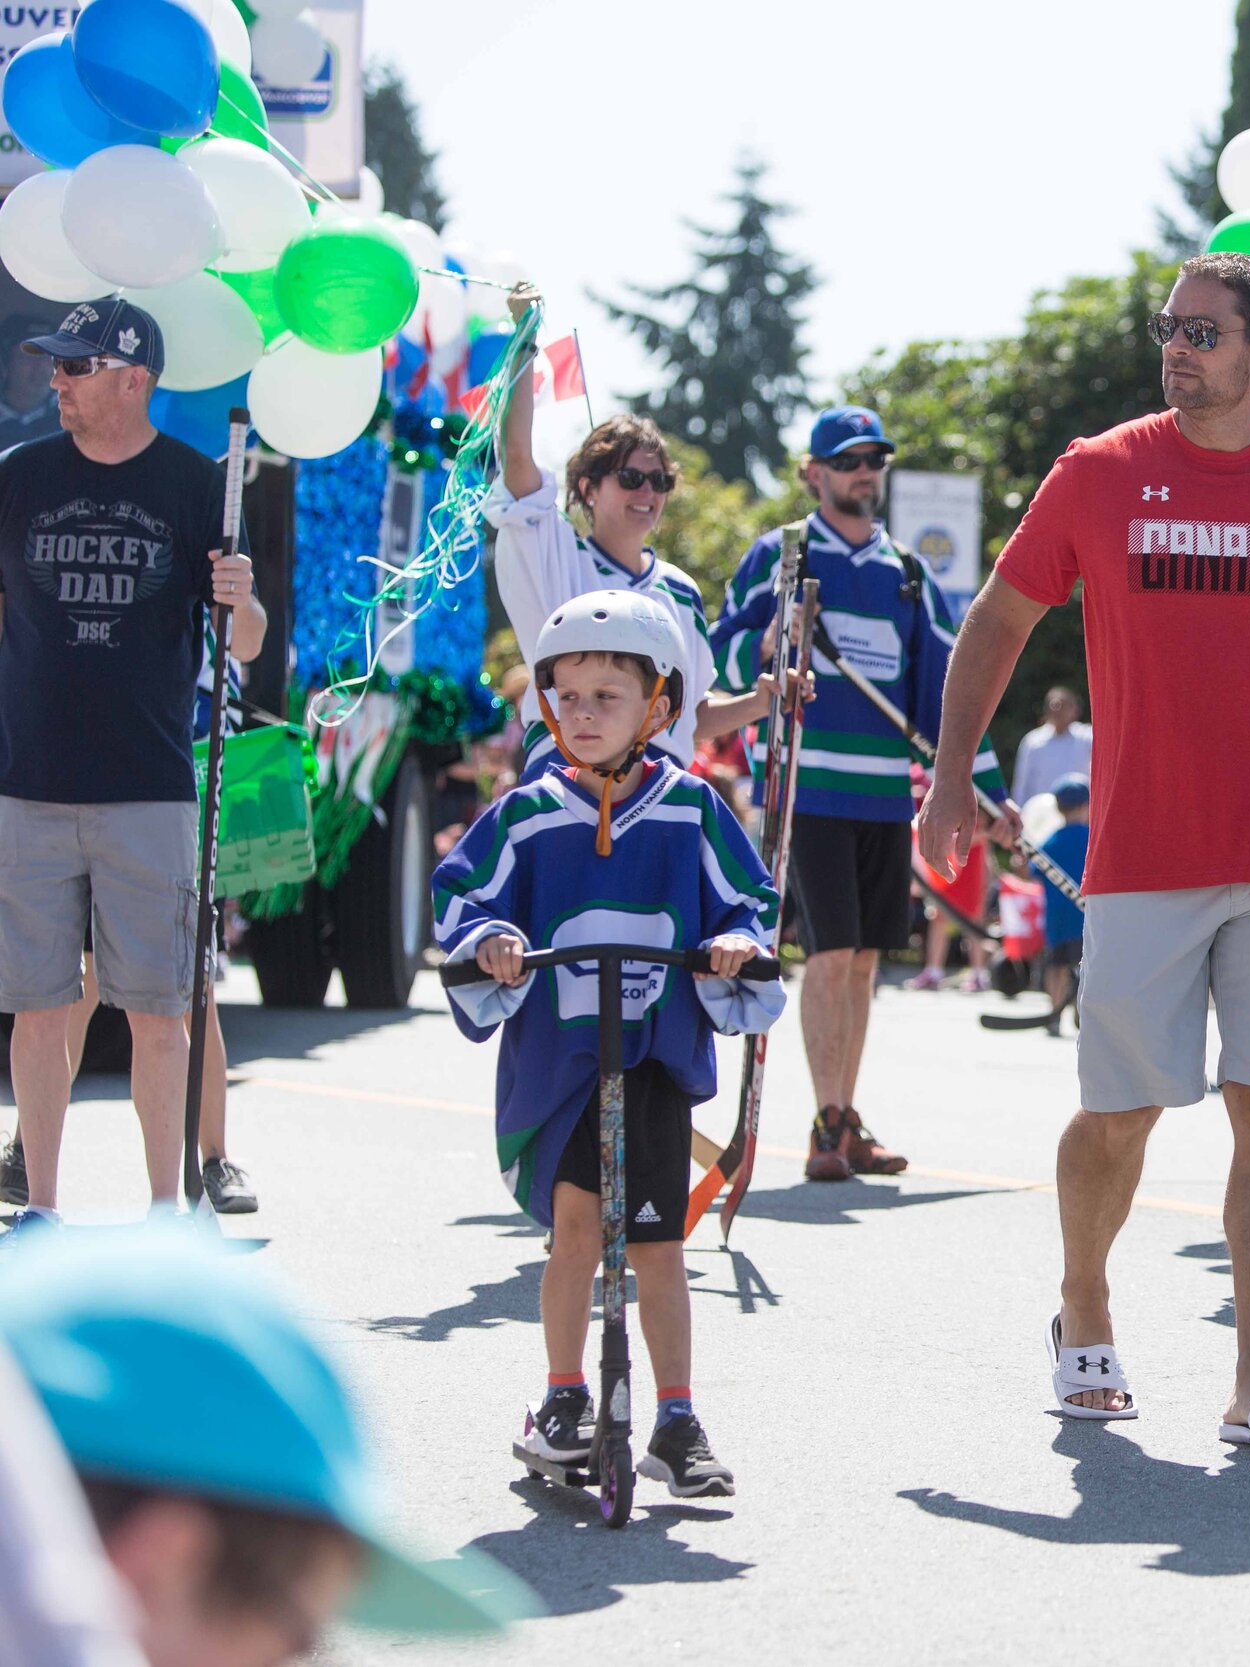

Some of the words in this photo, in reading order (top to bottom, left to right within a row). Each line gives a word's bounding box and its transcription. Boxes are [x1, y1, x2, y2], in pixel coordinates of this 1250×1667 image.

[120, 503, 132, 514] NO
[33, 534, 163, 569] HOCKEY
[58, 571, 135, 605] DAD
[77, 620, 111, 640] DSC
[616, 805, 646, 829] NORTH
[643, 770, 677, 805] VANCOUV
[634, 1215, 662, 1223] adidas
